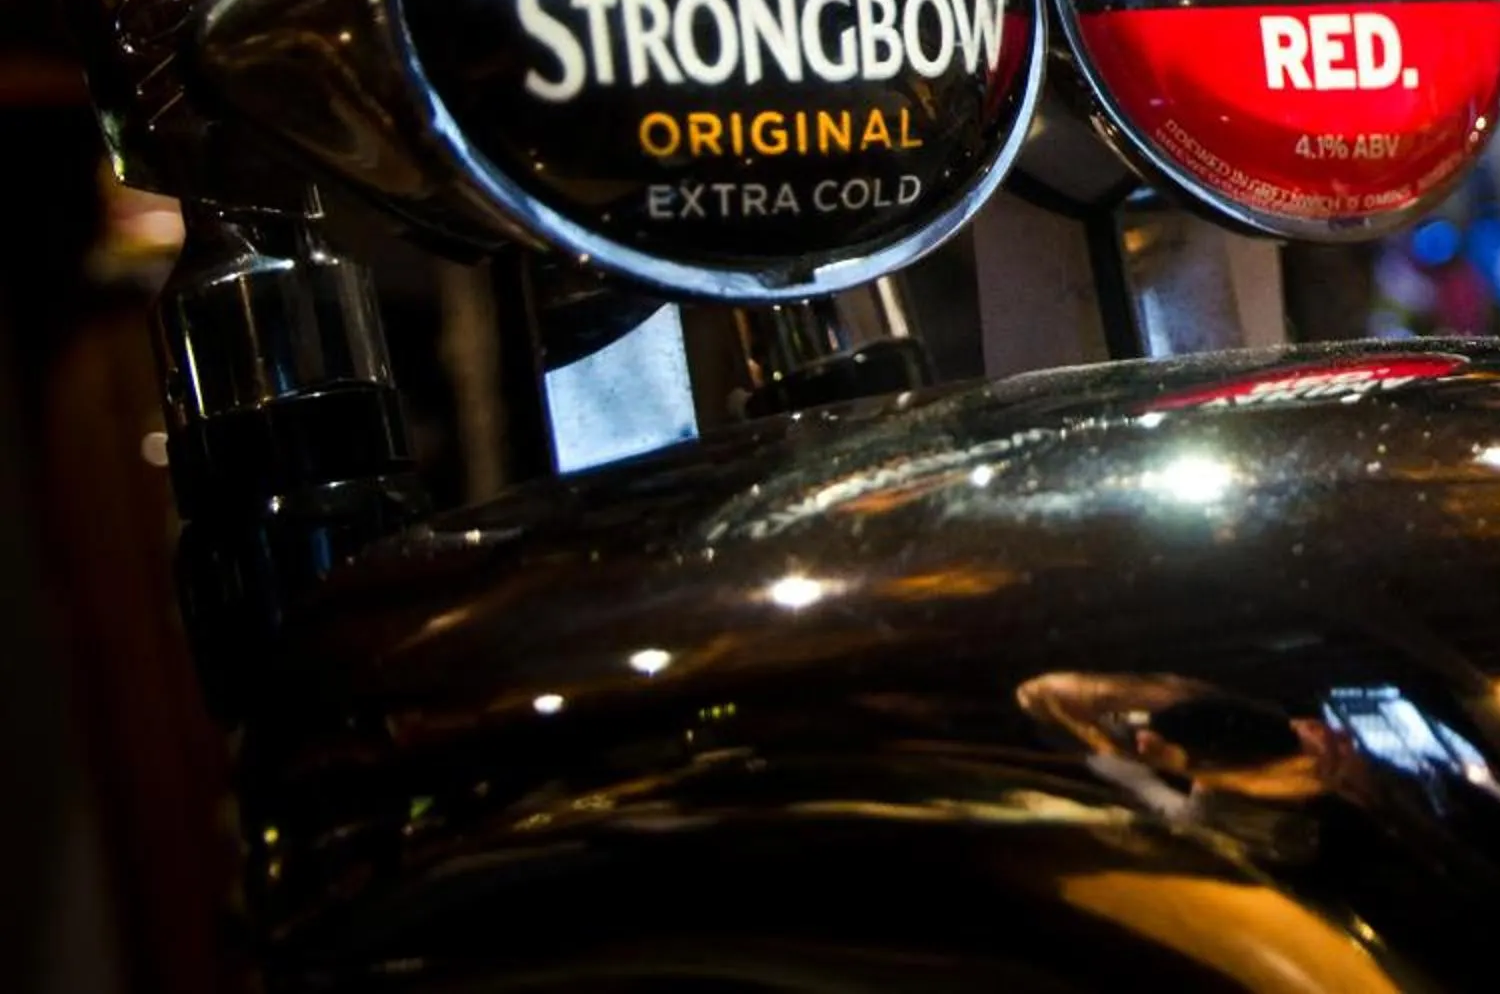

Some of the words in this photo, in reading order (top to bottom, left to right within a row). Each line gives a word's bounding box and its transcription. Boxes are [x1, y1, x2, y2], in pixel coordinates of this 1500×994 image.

[1260, 12, 1419, 92] RED.
[640, 107, 923, 157] ORIGINAL
[1295, 133, 1349, 159] 4.1%
[1351, 133, 1400, 158] ABV
[649, 181, 800, 220] EXTRA
[813, 174, 921, 214] COLD
